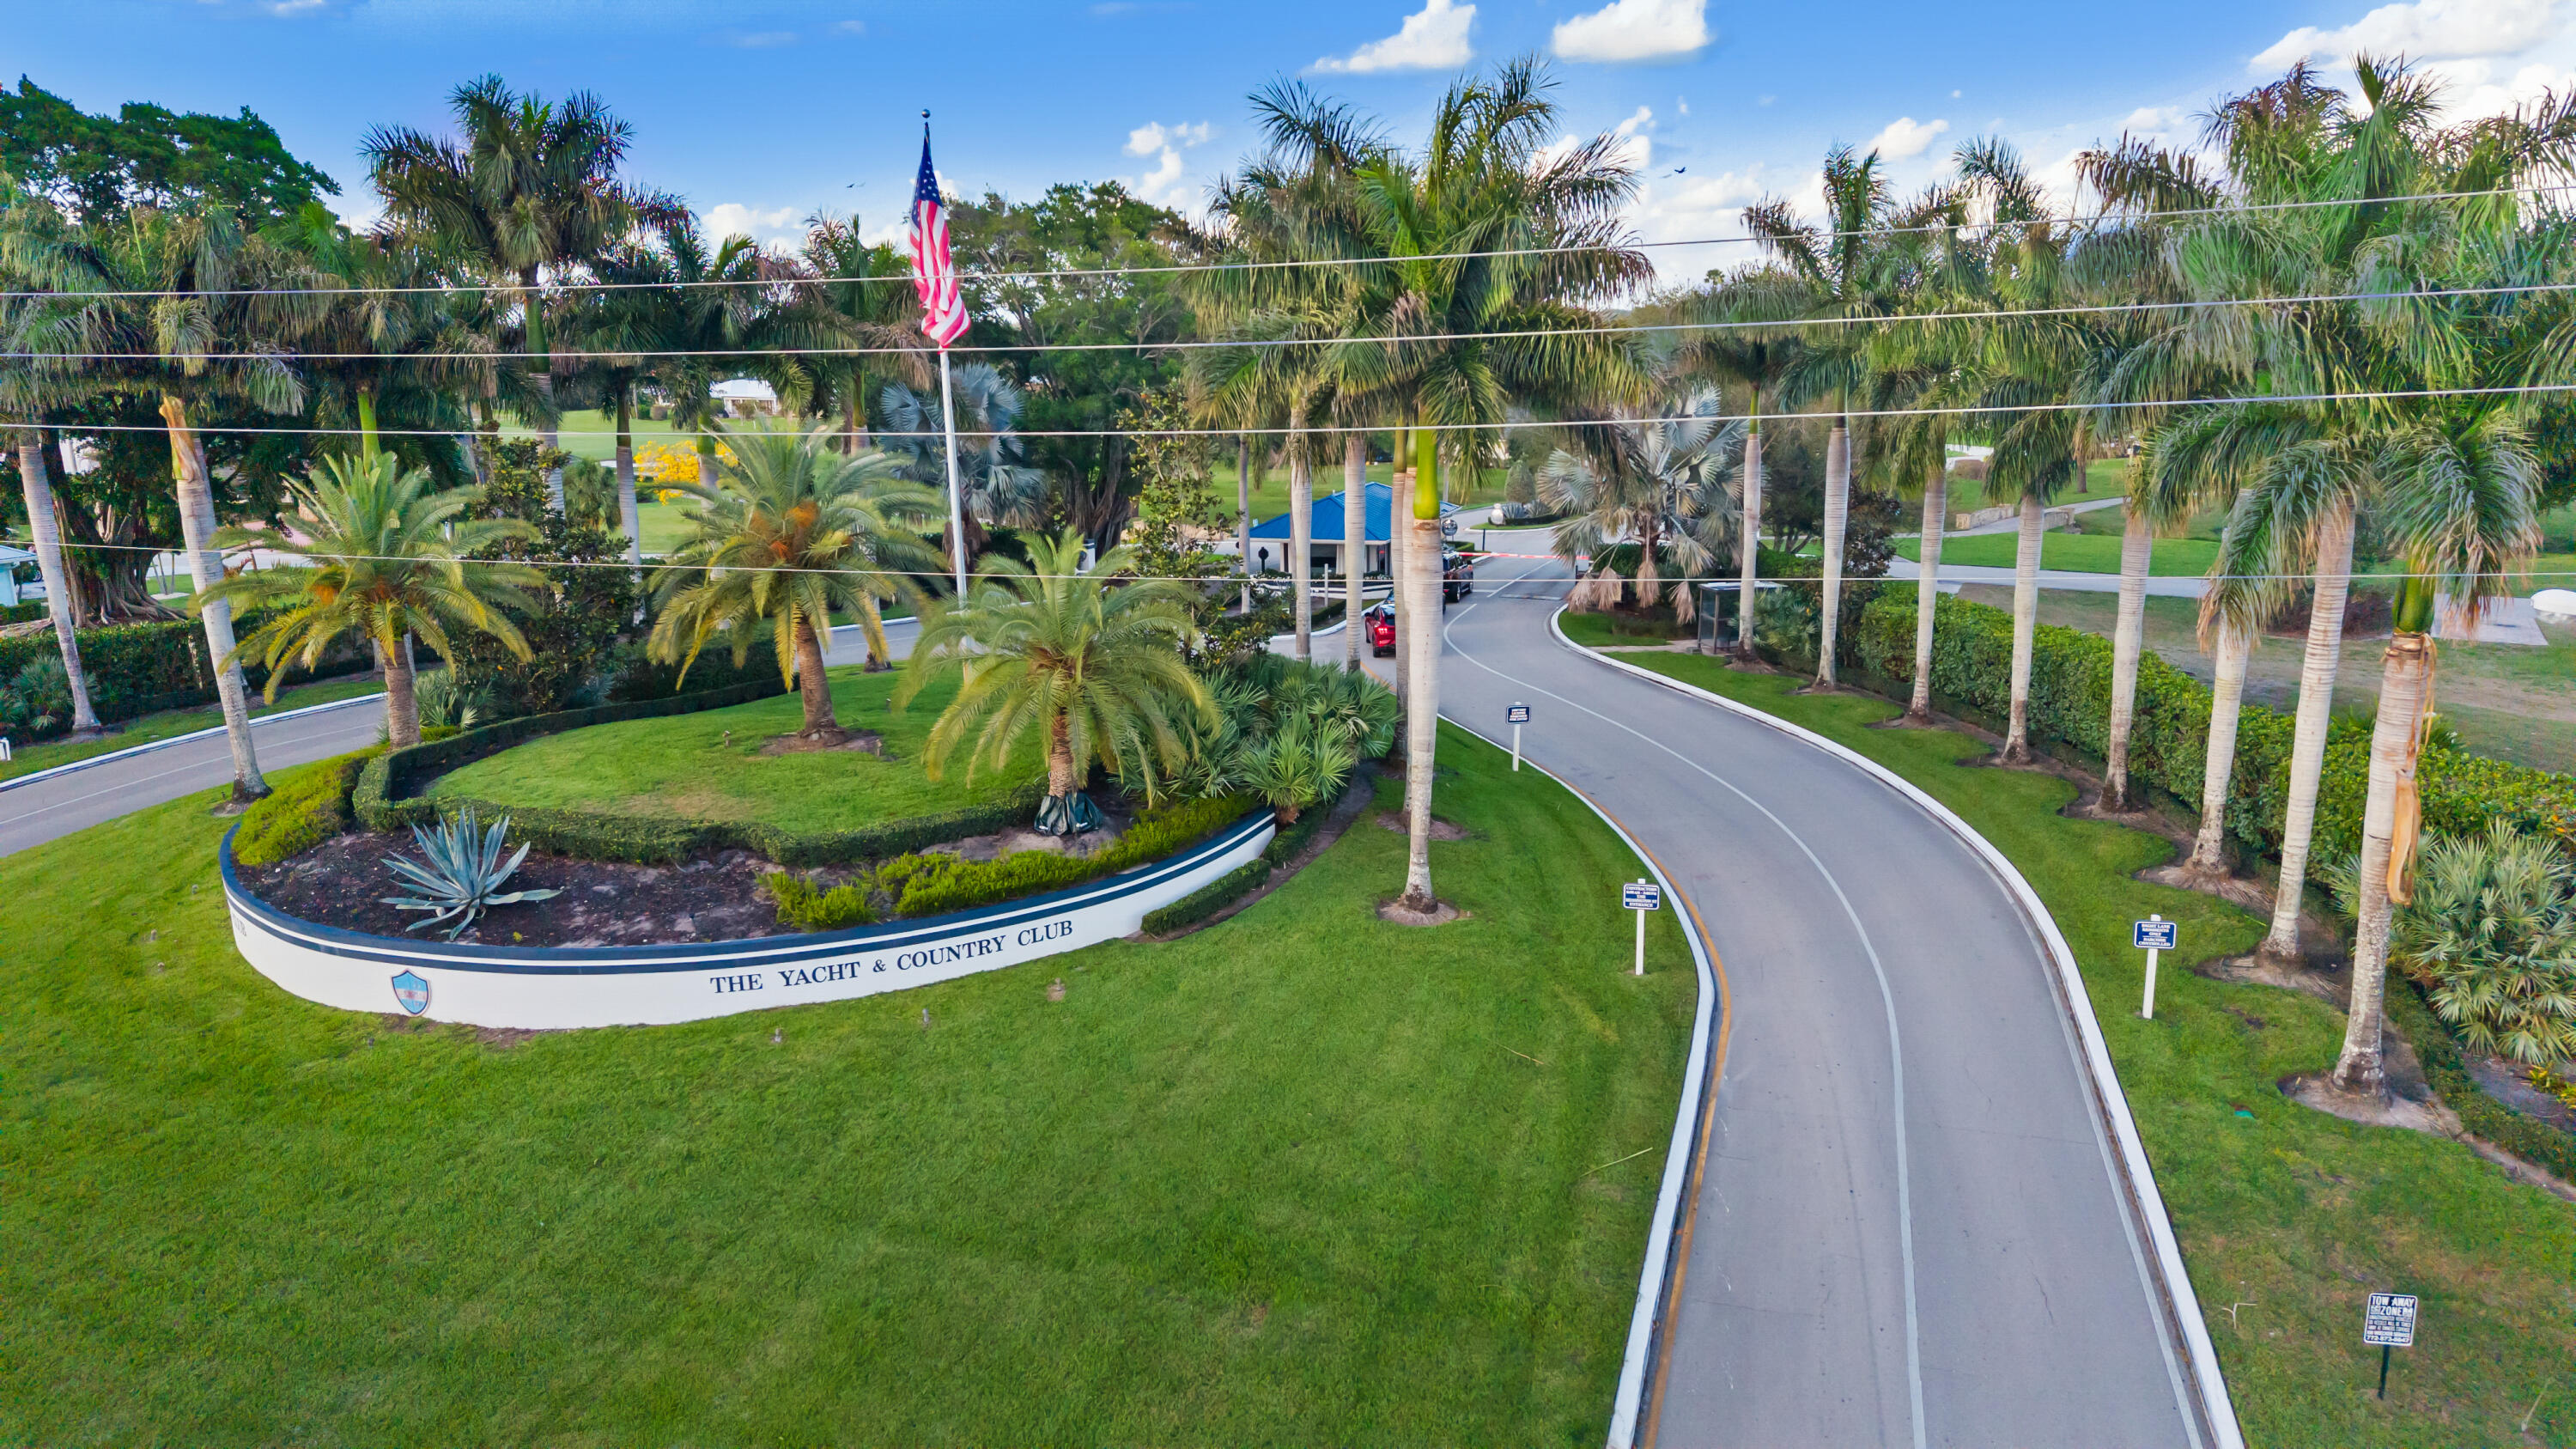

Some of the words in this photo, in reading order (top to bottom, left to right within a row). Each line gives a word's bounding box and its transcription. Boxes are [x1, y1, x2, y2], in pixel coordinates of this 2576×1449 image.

[710, 973, 763, 994] THE
[778, 961, 861, 987] YACHT
[872, 959, 886, 973] &
[896, 935, 1006, 971] COUNTRY
[1018, 920, 1072, 947] CLUB
[2372, 1296, 2389, 1306] TOW
[2391, 1297, 2415, 1307] AWAY
[2380, 1306, 2403, 1316] ZONE
